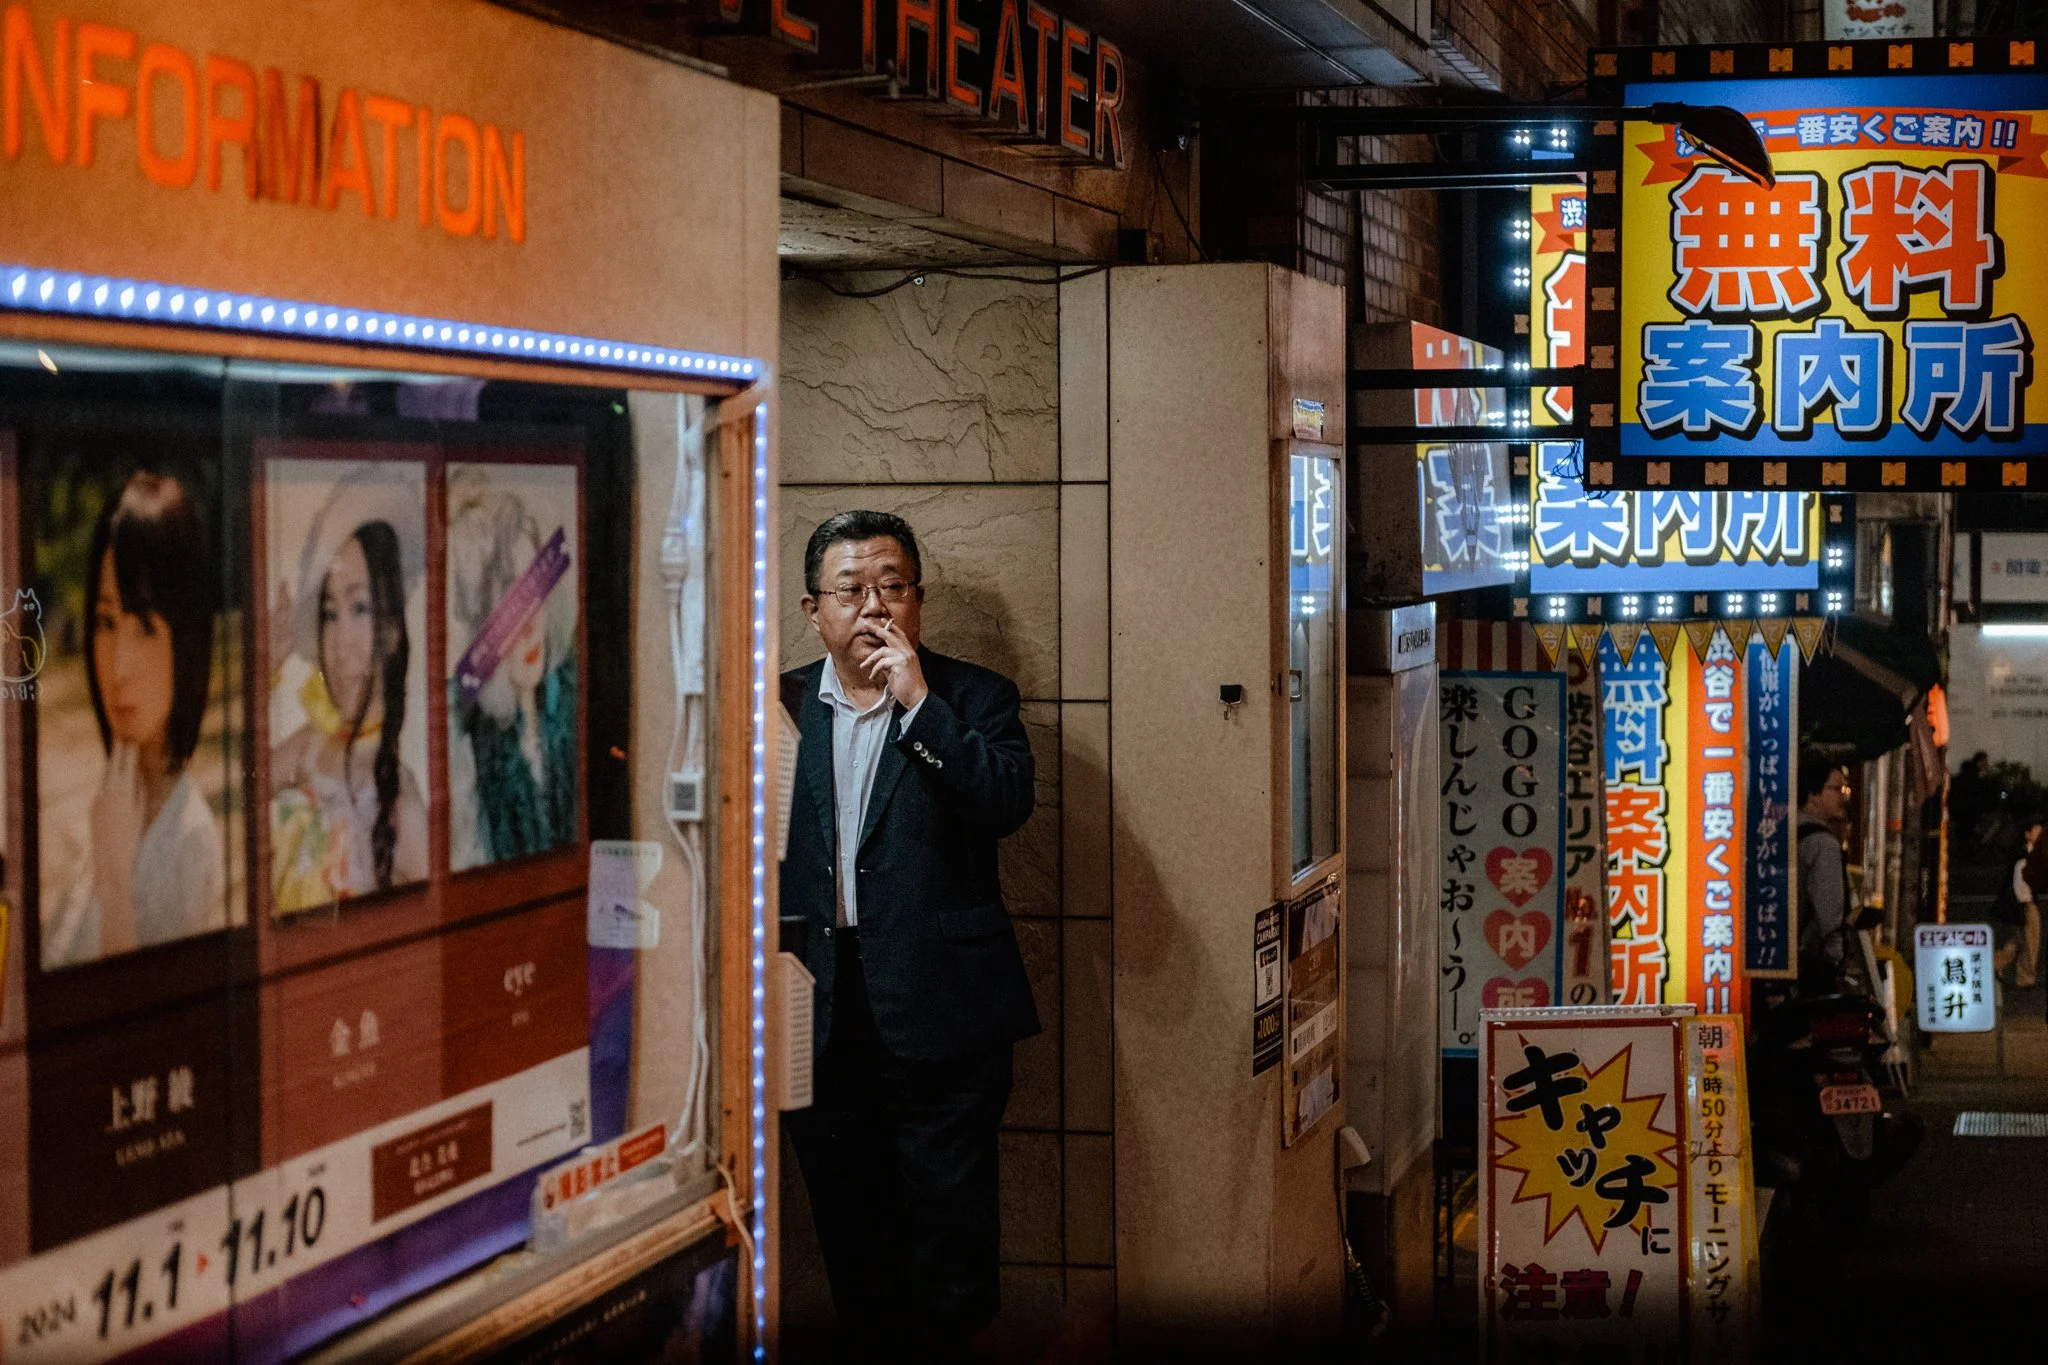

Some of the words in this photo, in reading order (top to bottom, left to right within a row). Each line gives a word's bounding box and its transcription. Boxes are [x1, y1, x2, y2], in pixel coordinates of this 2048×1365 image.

[1676, 112, 2018, 157] 一番安くご案内!!
[1671, 162, 1995, 314] 無料
[1640, 317, 2024, 434] 案内所
[1533, 442, 1808, 558] 案内所
[92, 1242, 182, 1340] 11.1
[222, 1184, 326, 1288] 11.10
